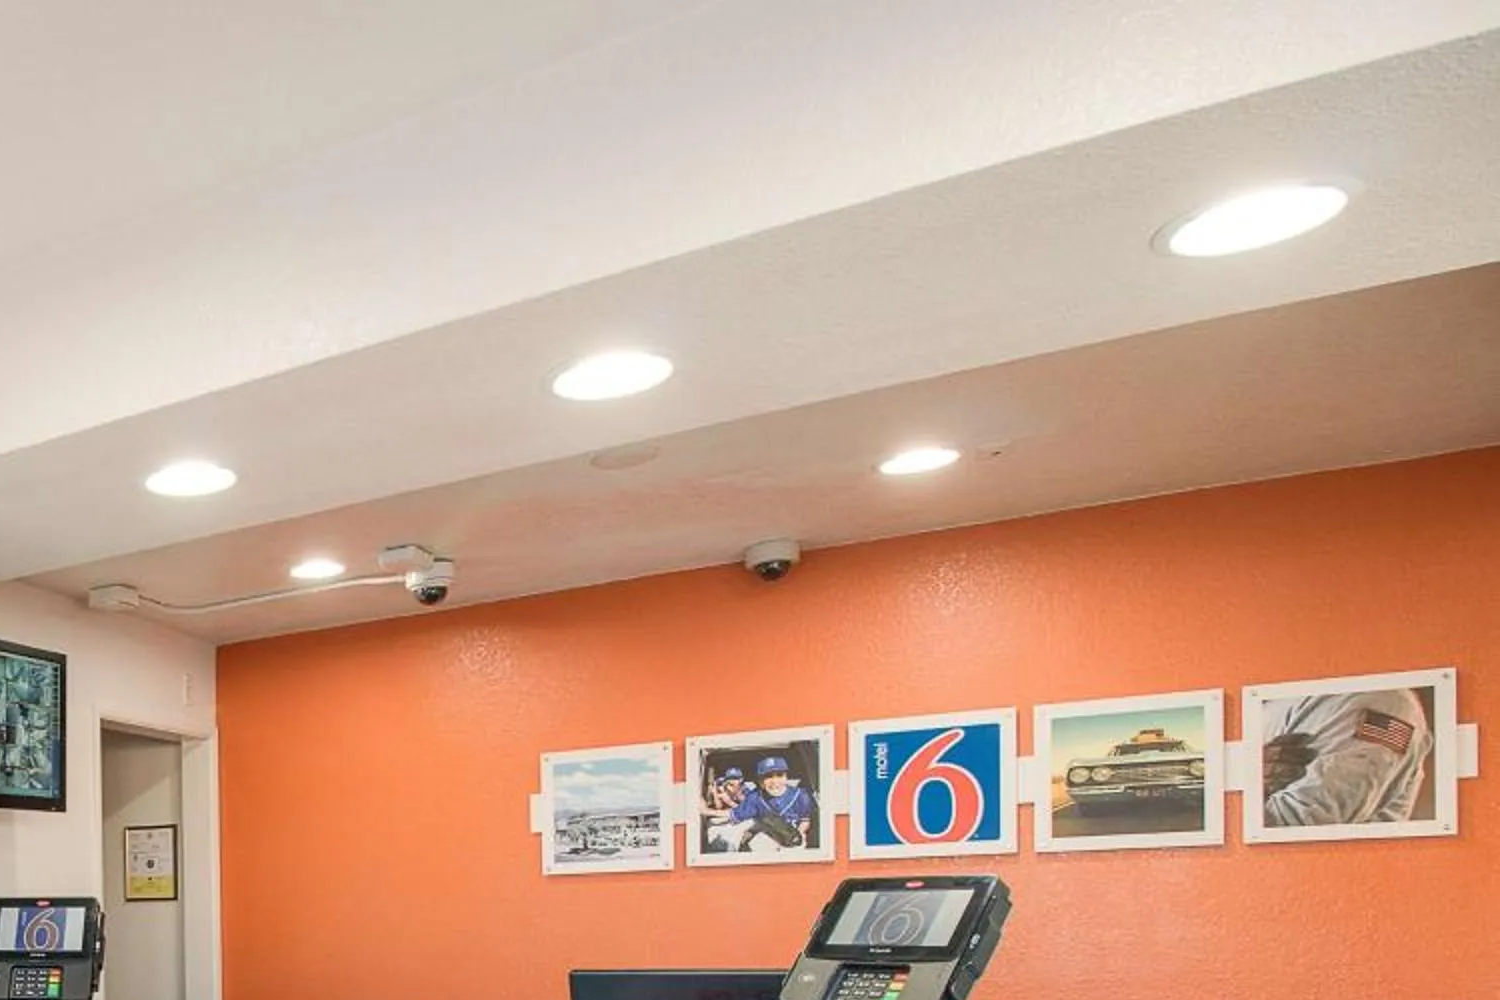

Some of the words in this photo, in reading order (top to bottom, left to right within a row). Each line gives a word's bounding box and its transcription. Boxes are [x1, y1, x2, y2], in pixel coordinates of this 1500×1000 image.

[873, 742, 888, 779] motel
[886, 728, 984, 844] 6
[24, 907, 59, 951] 6
